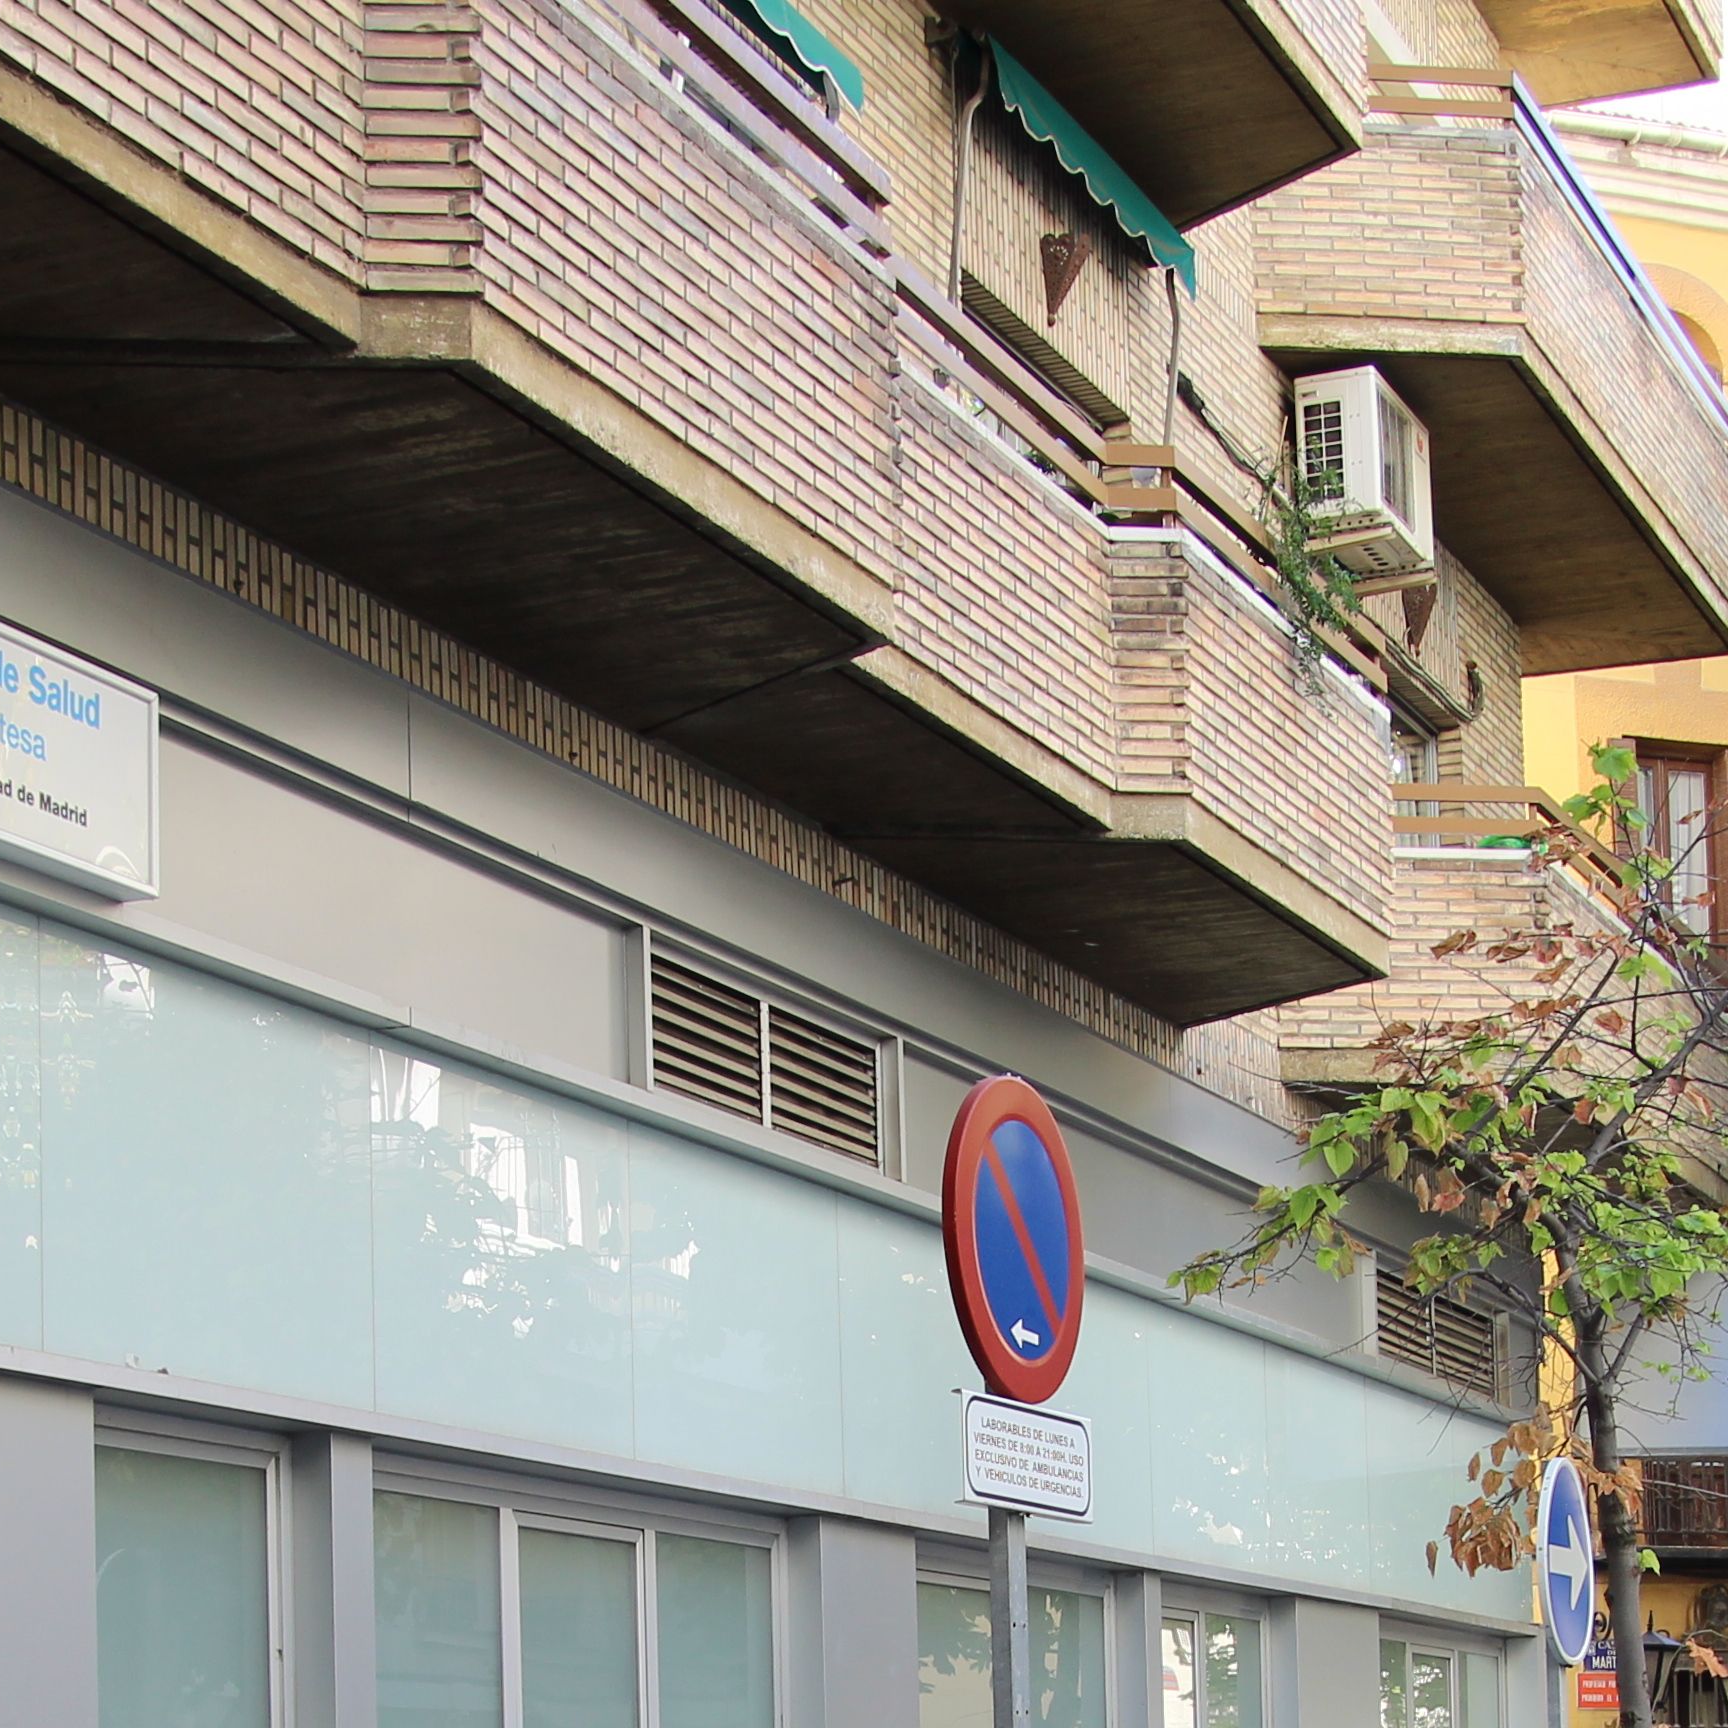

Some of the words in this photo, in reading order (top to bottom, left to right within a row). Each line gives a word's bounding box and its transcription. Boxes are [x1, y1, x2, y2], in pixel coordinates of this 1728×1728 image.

[28, 665, 101, 729] Salud
[17, 785, 35, 806] de
[39, 792, 88, 827] Madrid
[974, 1432, 1007, 1450] VIERNES
[1008, 1440, 1018, 1452] DE
[1020, 1443, 1034, 1455] 8:00
[1036, 1447, 1042, 1457] A
[1068, 1453, 1084, 1467] USO
[981, 1417, 1032, 1439] LABORABLES
[1033, 1429, 1044, 1441] DE
[1045, 1432, 1068, 1447] LUNES
[1070, 1438, 1075, 1449] A
[975, 1449, 1017, 1468] EXCLUSIVO
[1019, 1458, 1029, 1471] DE
[1032, 1462, 1084, 1482] AMBULANCIAS
[976, 1466, 981, 1478] Y
[1028, 1476, 1039, 1489] DE
[1040, 1480, 1084, 1498] URGENCIAS.
[1592, 1656, 1616, 1669] MART
